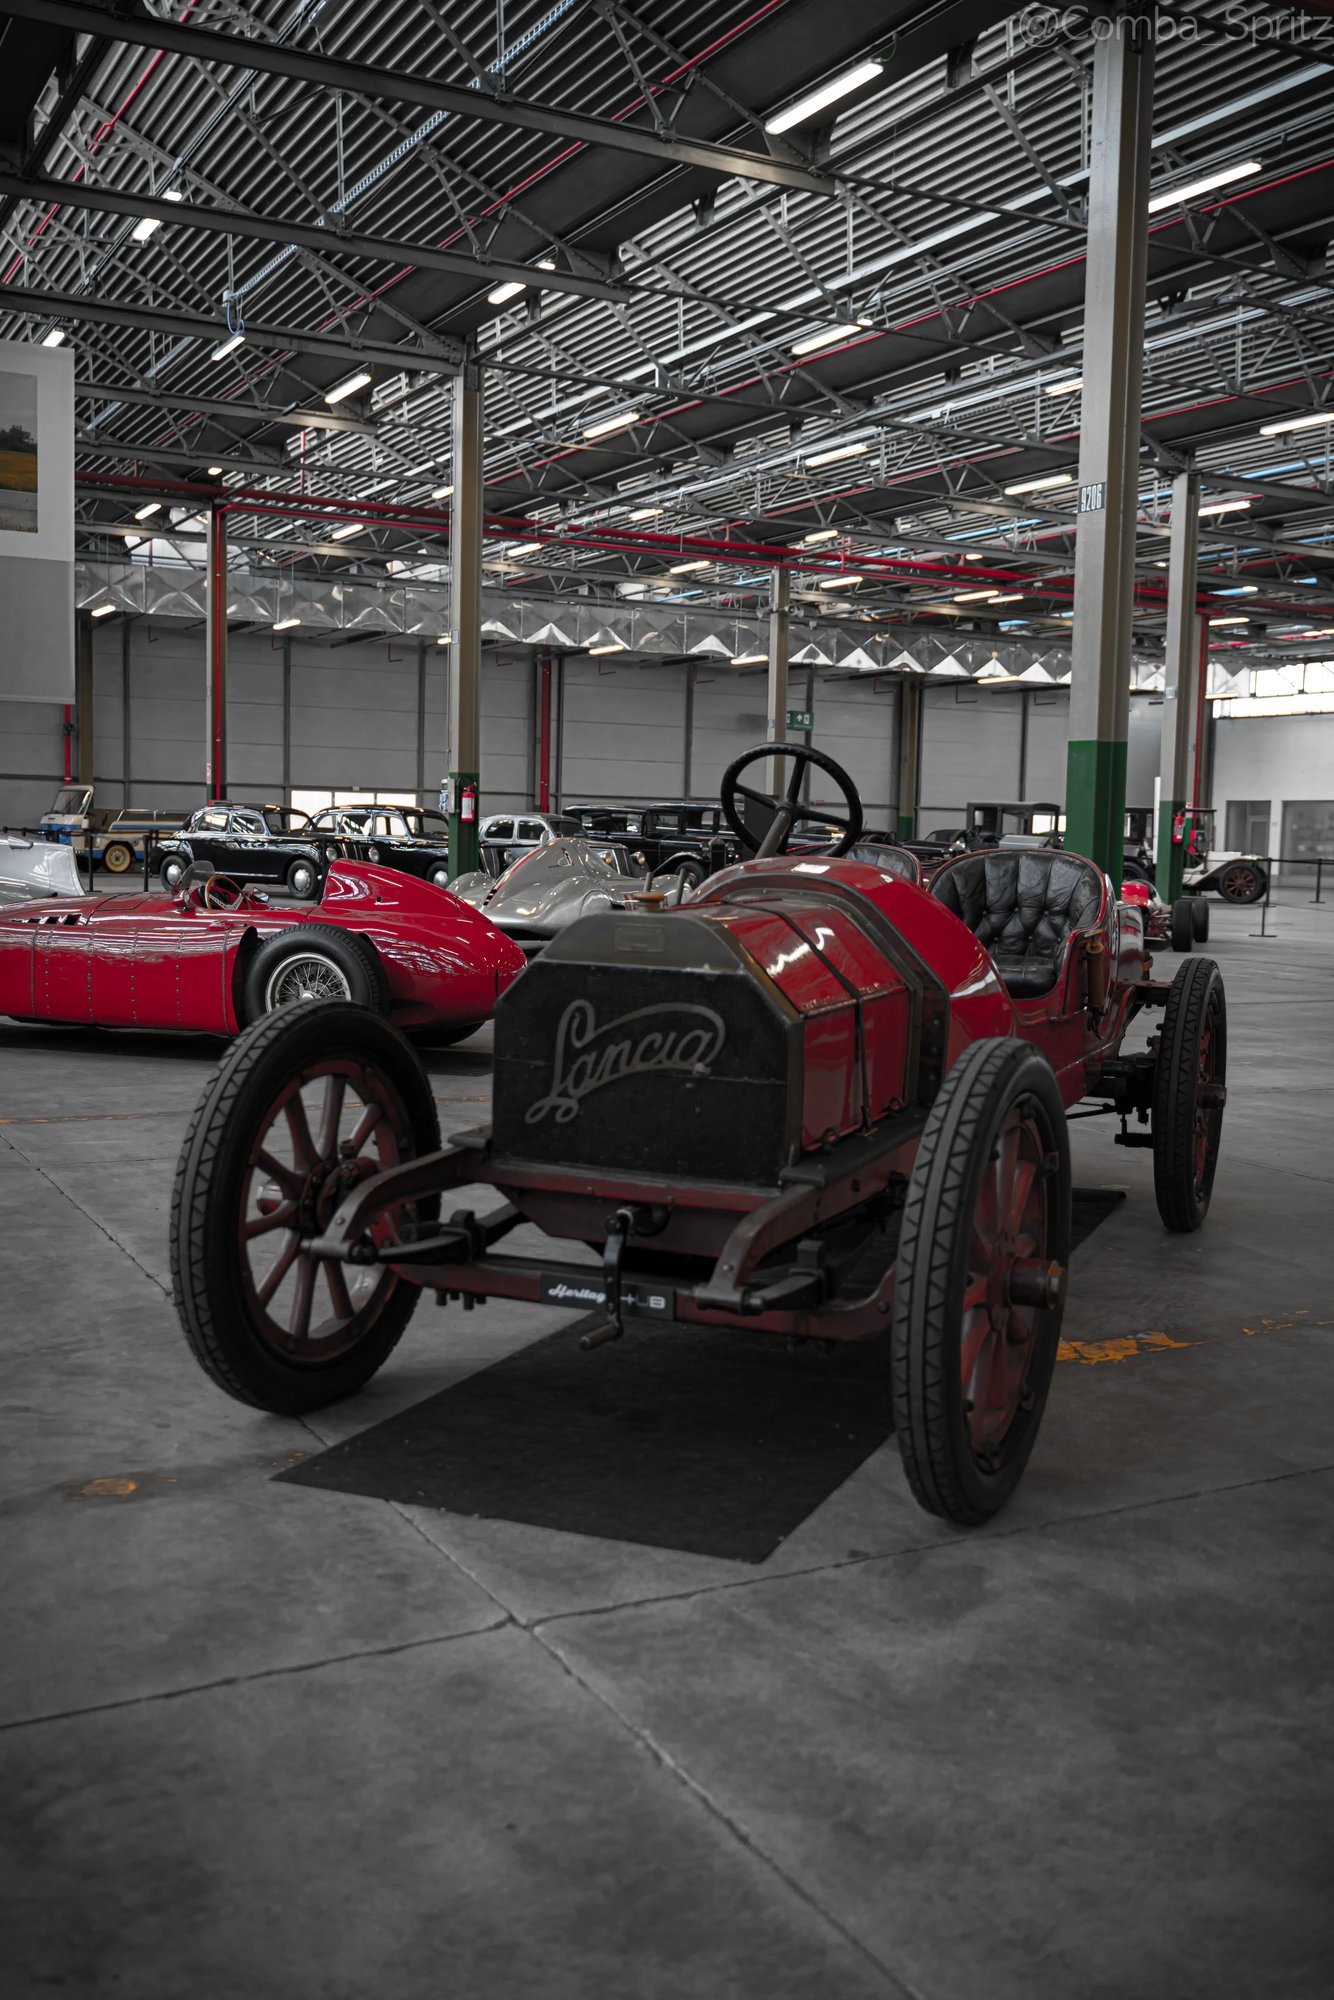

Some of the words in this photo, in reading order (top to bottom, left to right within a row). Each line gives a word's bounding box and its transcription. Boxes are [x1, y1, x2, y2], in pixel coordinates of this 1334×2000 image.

[1081, 483, 1102, 512] 9206
[525, 999, 726, 1123] Lancia
[548, 1283, 606, 1304] Heritag
